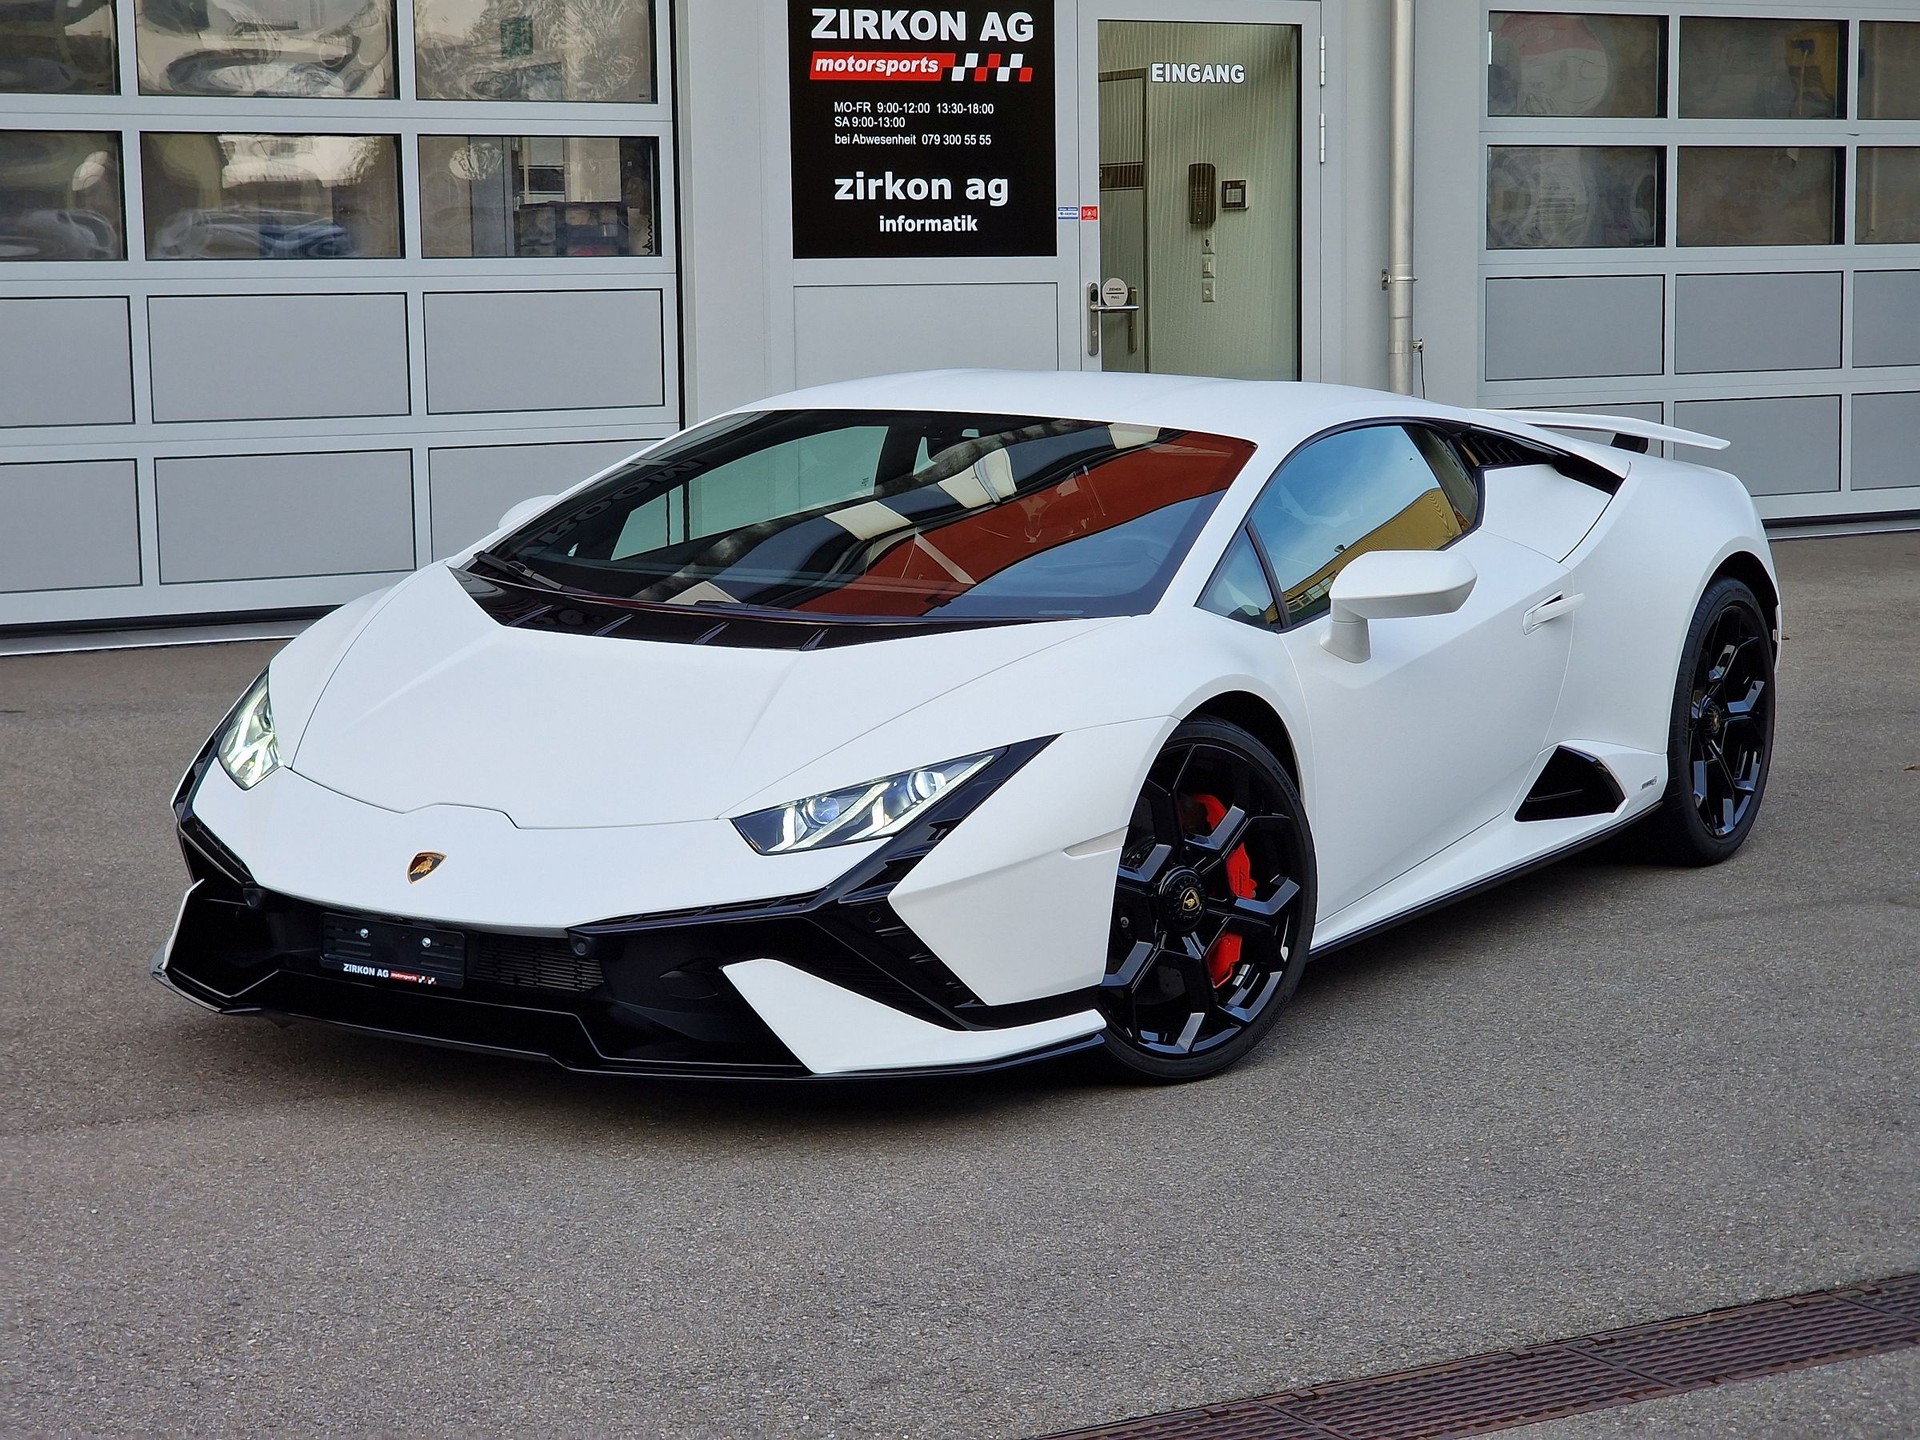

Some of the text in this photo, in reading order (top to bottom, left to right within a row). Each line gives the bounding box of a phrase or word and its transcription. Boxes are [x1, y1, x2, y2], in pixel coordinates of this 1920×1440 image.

[810, 8, 1034, 42] ZIRKON AG
[815, 55, 939, 77] motorsports
[1151, 63, 1246, 83] EINGANG
[834, 101, 995, 115] MO-FR 9:00-12:00 13:30-18:00
[834, 115, 906, 128] SA 9:00-13:00
[834, 133, 992, 146] bei Abwesenheit 079 300 55 55
[834, 171, 1009, 207] zirkon ag
[879, 215, 978, 232] informatik
[343, 963, 390, 978] ZIRKON AG
